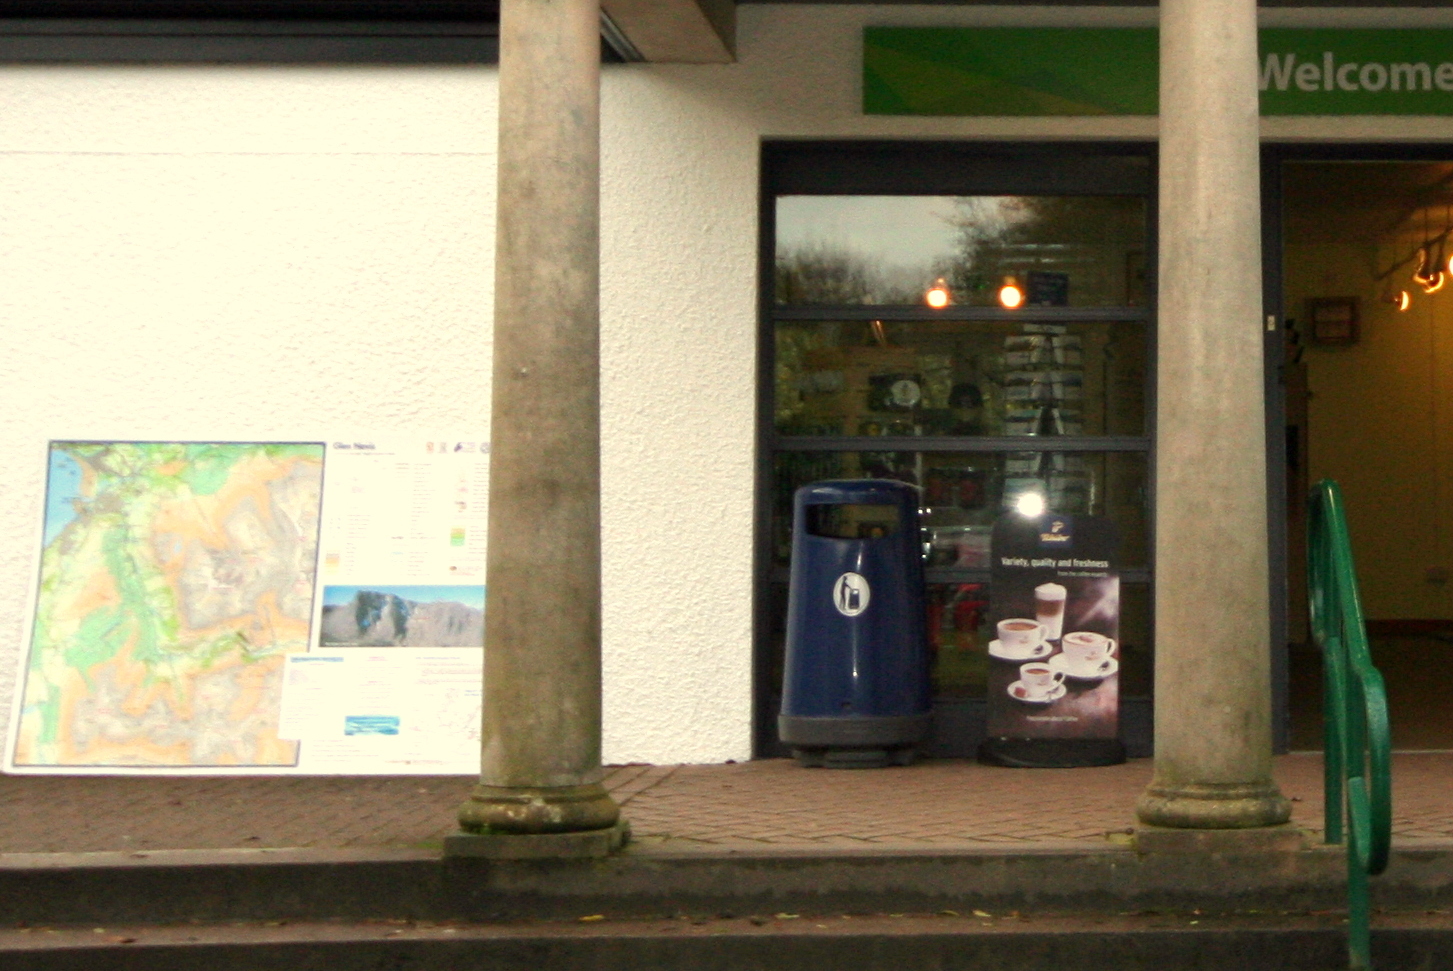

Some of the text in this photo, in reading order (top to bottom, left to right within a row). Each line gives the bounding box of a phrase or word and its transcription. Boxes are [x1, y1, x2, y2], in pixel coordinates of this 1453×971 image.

[1001, 557, 1109, 569] Variety, quality and freshness
